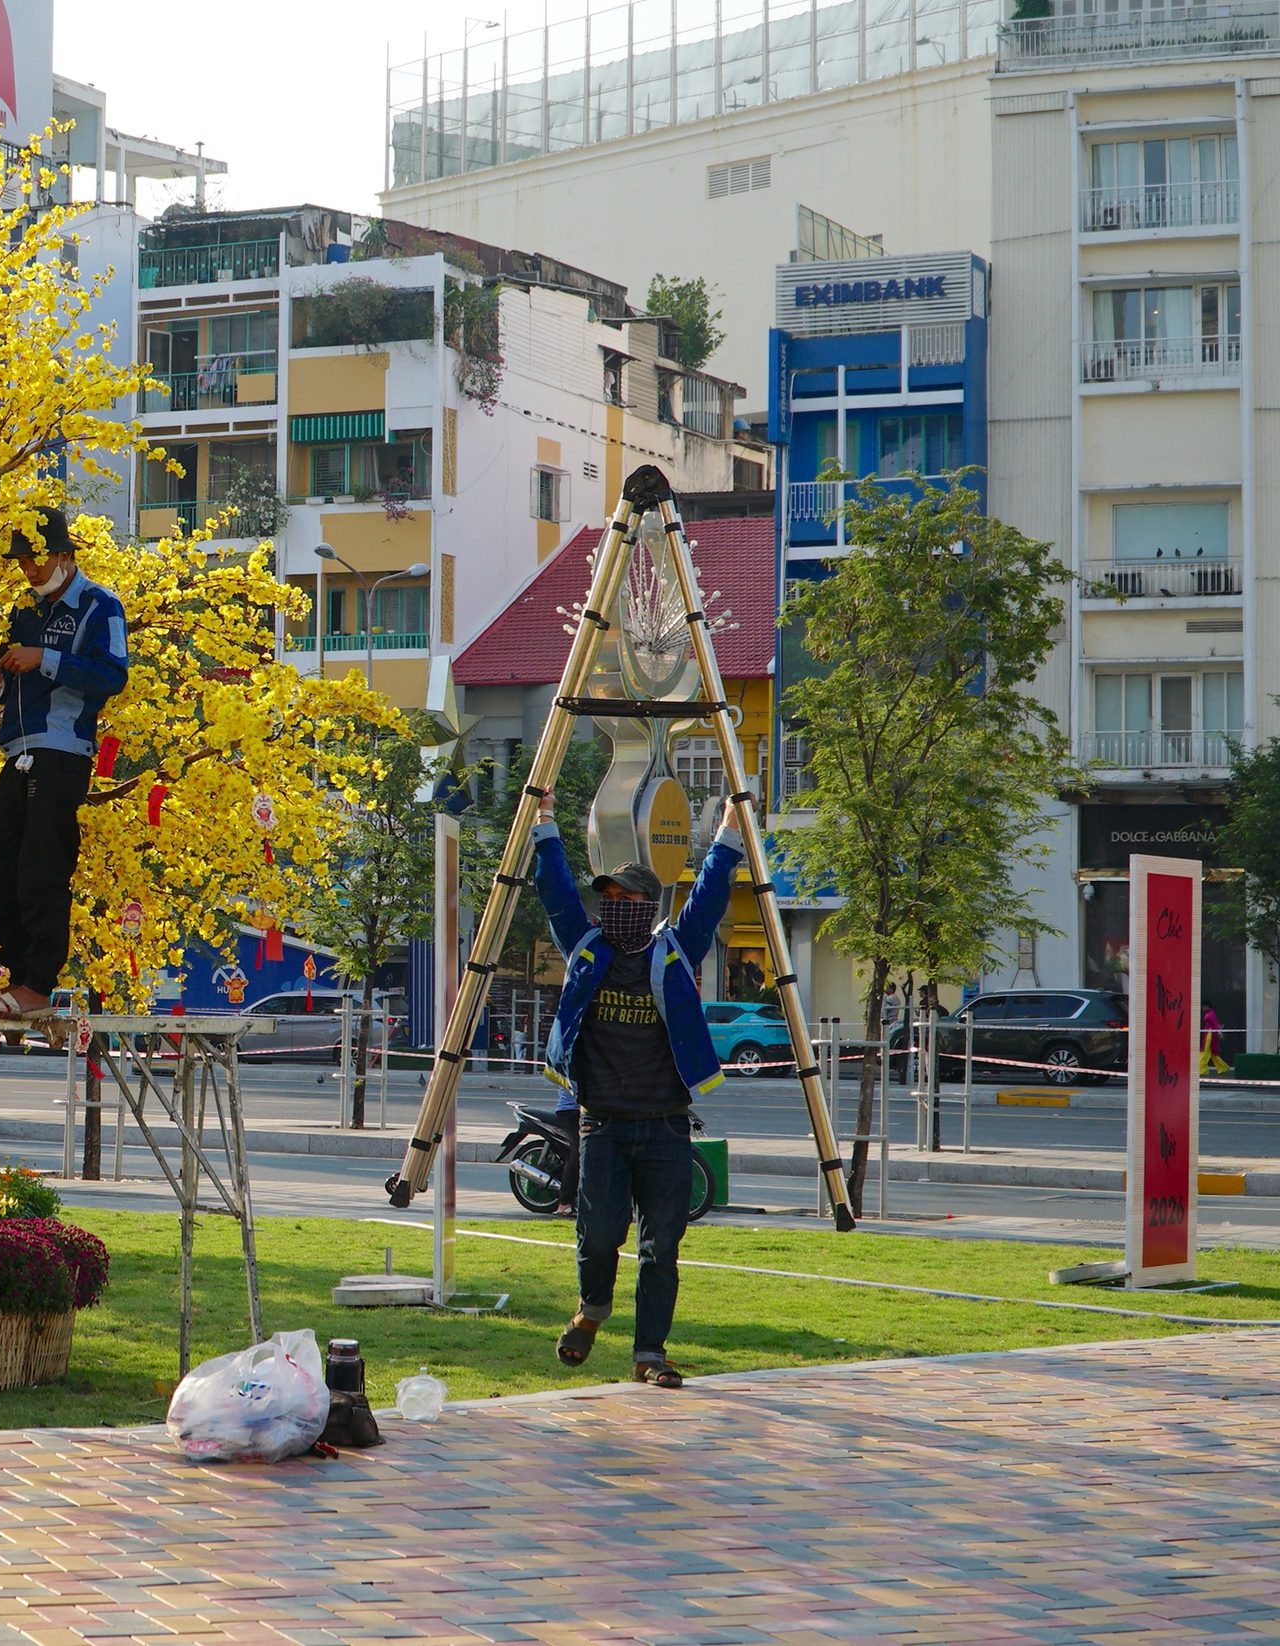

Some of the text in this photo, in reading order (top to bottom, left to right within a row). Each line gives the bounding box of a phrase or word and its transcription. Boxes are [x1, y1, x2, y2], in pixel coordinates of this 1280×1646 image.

[795, 276, 948, 308] EXIMBANK
[592, 989, 657, 1007] mirat
[598, 1006, 657, 1024] FLY BETTER
[1149, 1196, 1184, 1226] 2026
